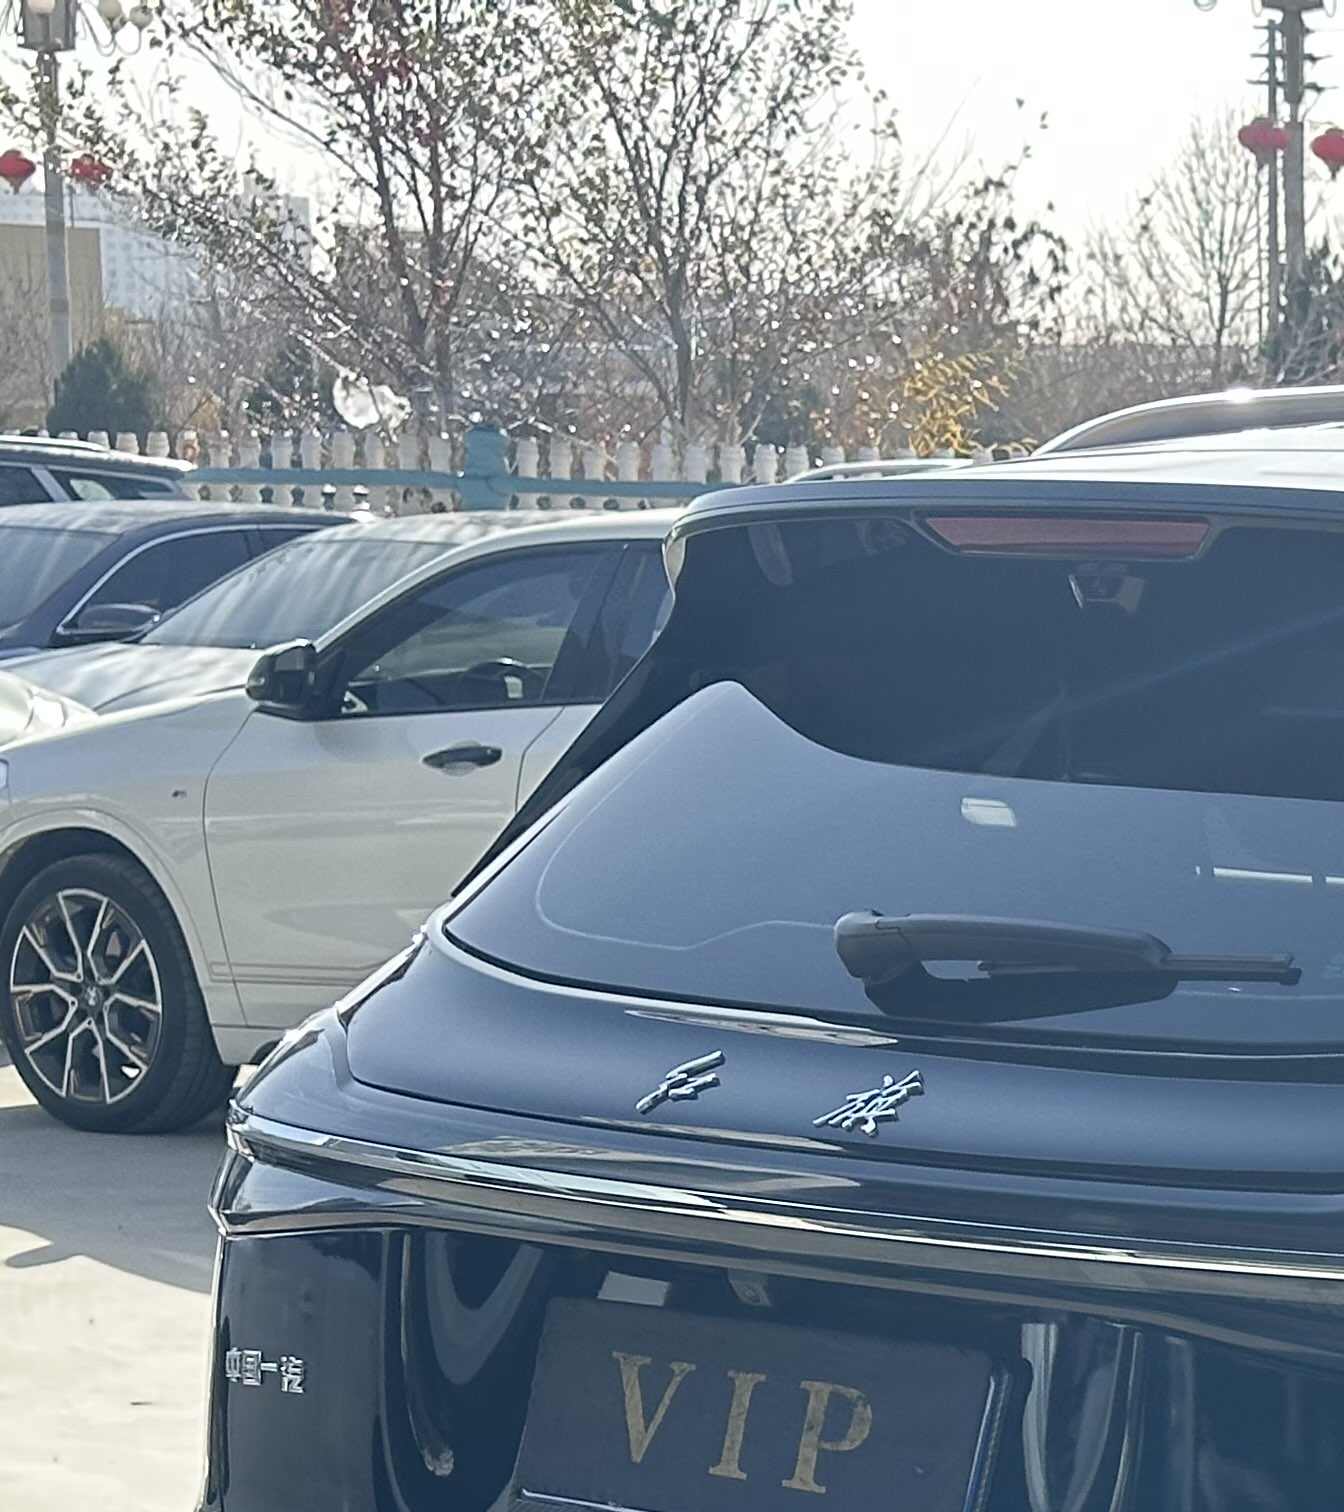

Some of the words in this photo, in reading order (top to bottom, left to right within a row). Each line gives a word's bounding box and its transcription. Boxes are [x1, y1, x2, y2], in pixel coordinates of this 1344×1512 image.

[225, 1346, 305, 1394] 中国一汽
[612, 1351, 874, 1494] VIP
